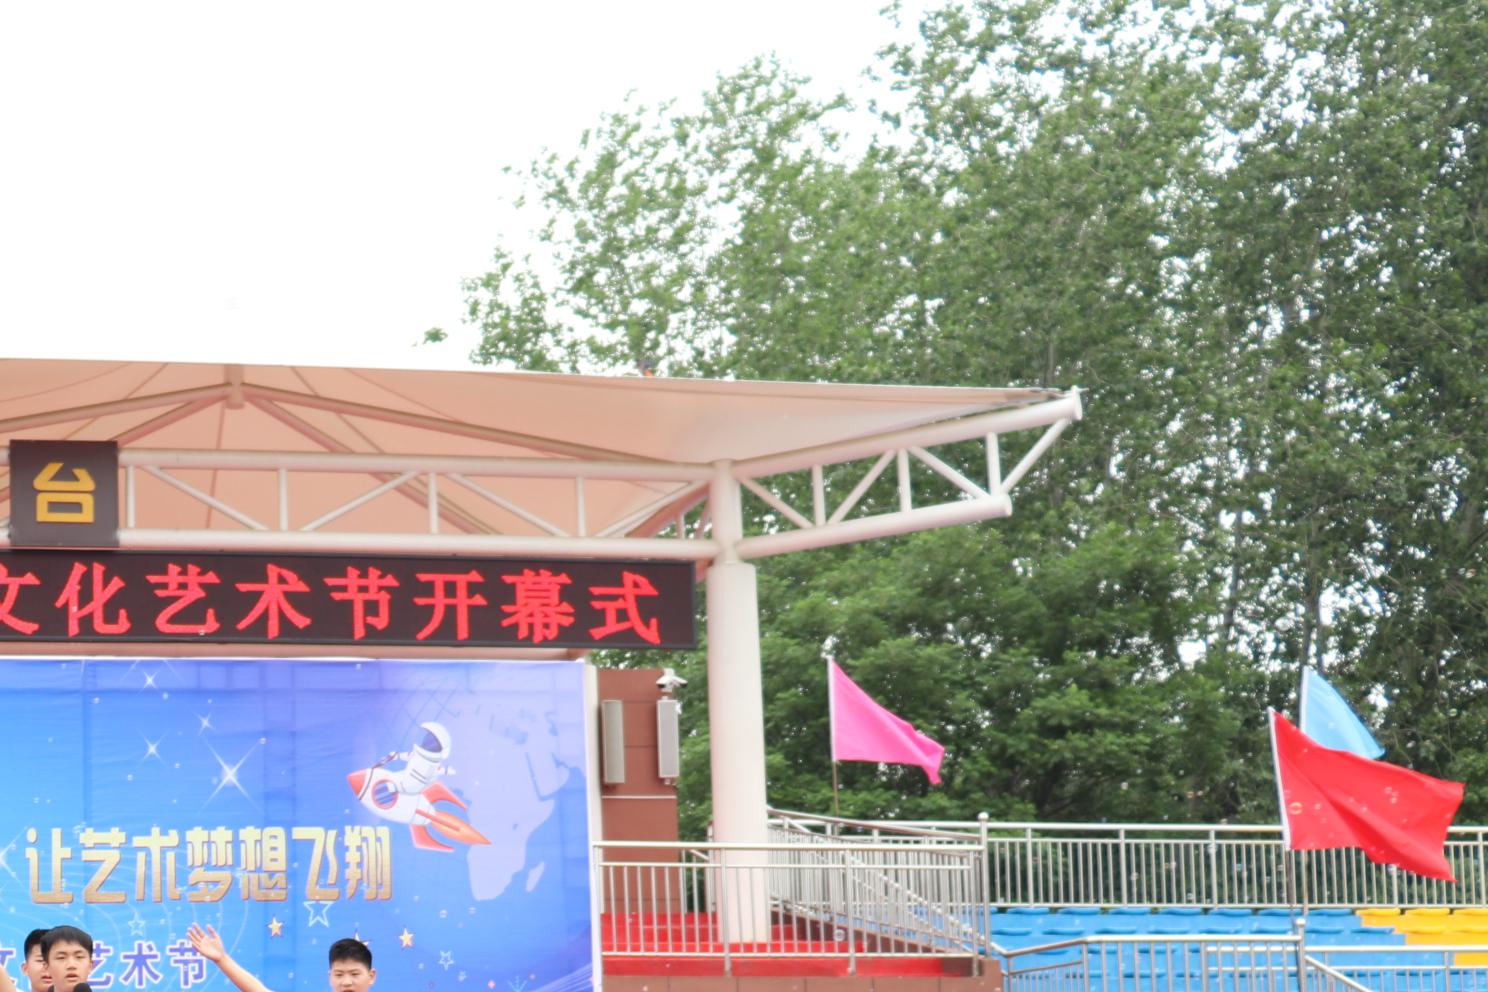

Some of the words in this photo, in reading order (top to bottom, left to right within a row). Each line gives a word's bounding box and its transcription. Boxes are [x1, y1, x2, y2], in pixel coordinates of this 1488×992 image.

[33, 462, 96, 524] 台
[25, 826, 392, 904] 让艺术梦想飞翔
